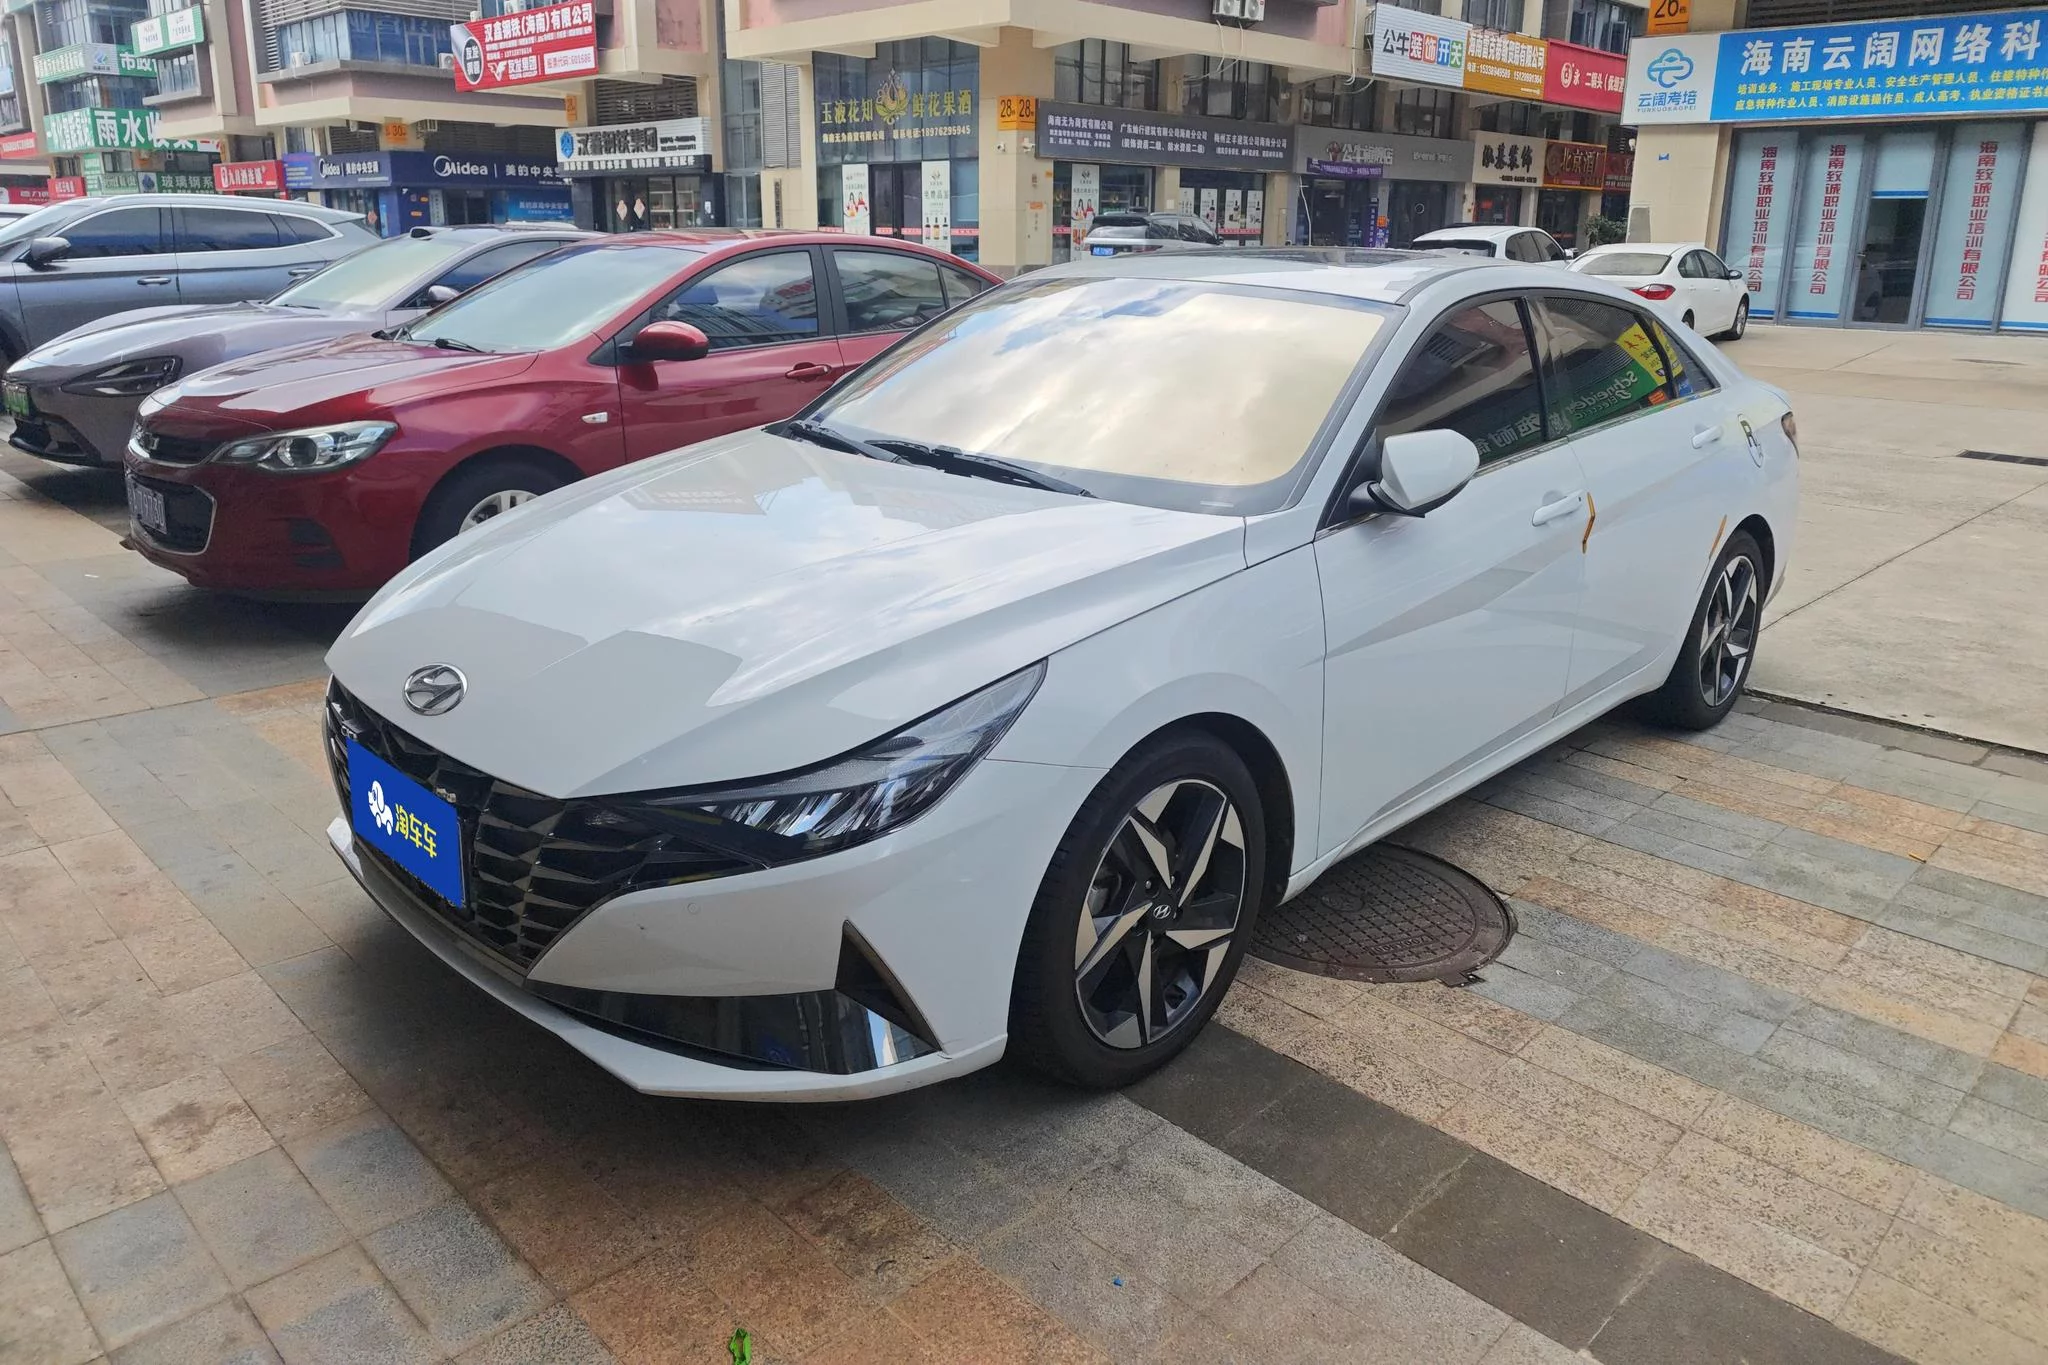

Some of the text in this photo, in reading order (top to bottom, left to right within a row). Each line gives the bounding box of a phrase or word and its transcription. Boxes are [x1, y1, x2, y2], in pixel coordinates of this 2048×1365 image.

[1383, 28, 1463, 66] 公牛装饰开关
[1740, 19, 2041, 76] 海南云阔网络科
[121, 52, 158, 73] 市政
[913, 89, 972, 118] 鲜花果酒
[1638, 91, 1697, 107] 云阔考培
[1047, 115, 1113, 131] 海南无为商贸有限公司
[319, 158, 340, 178] Midea
[433, 155, 488, 177] Midea
[1747, 146, 1778, 293] 海南致诚职业培训有限公司
[1810, 144, 1846, 295] 海南致诚职业培训有限公司
[1956, 141, 1998, 301] 海南致诚职业培训有限公司
